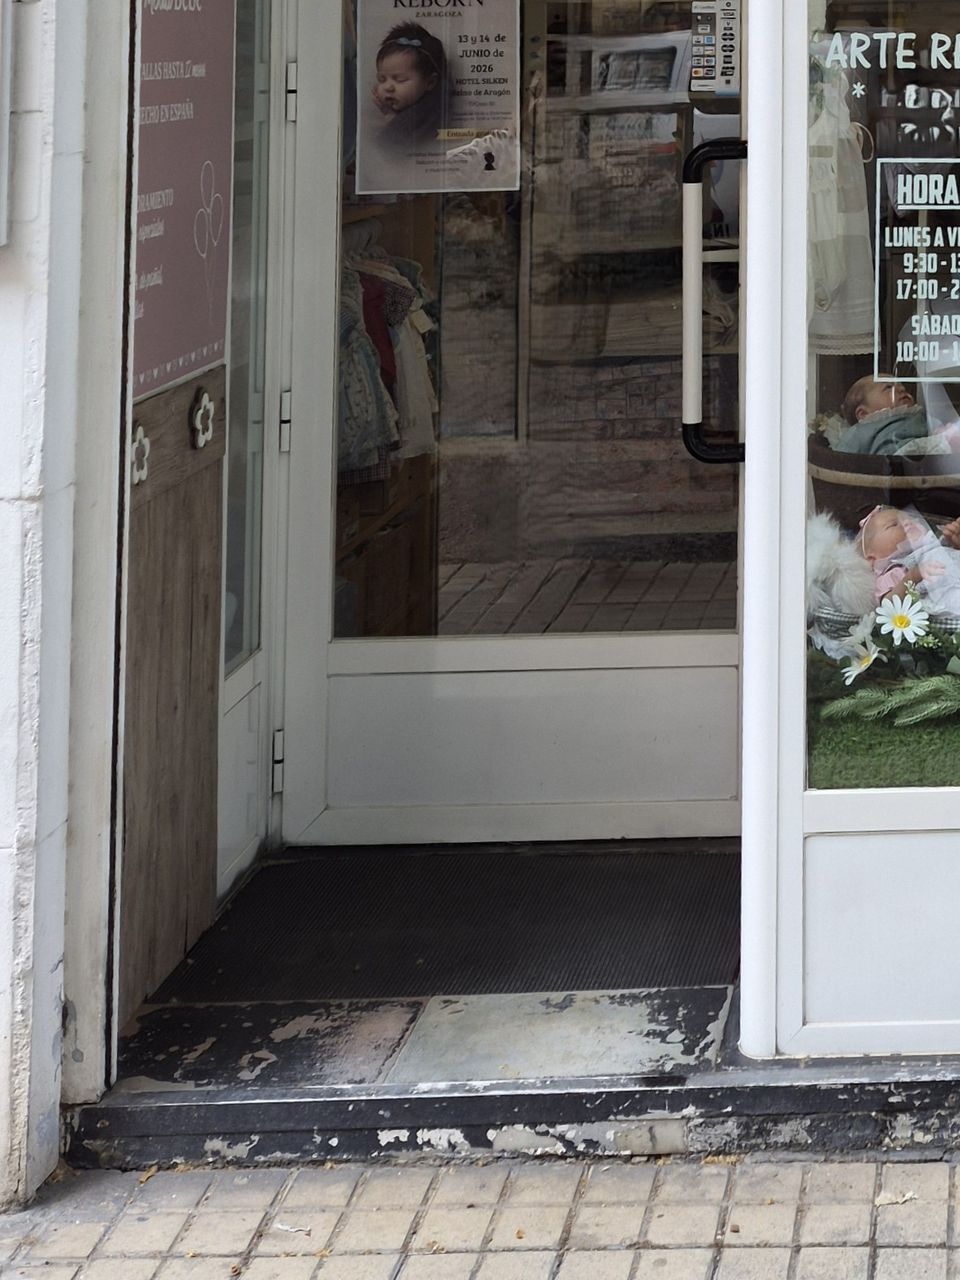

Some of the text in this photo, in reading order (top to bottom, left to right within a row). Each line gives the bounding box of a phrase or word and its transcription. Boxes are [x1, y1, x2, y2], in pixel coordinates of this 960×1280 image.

[414, 10, 464, 18] ZARAGOZA
[458, 33, 507, 45] 13 y 14 de
[459, 48, 504, 58] JUNIO de
[824, 32, 917, 70] ARTE
[456, 77, 508, 85] HOTEL SILKEN
[484, 87, 511, 98] Aragón
[884, 226, 931, 248] LUNES
[933, 226, 945, 248] A
[903, 252, 938, 274] 9:30
[896, 278, 938, 300] 17:00
[896, 341, 940, 362] 10:00
